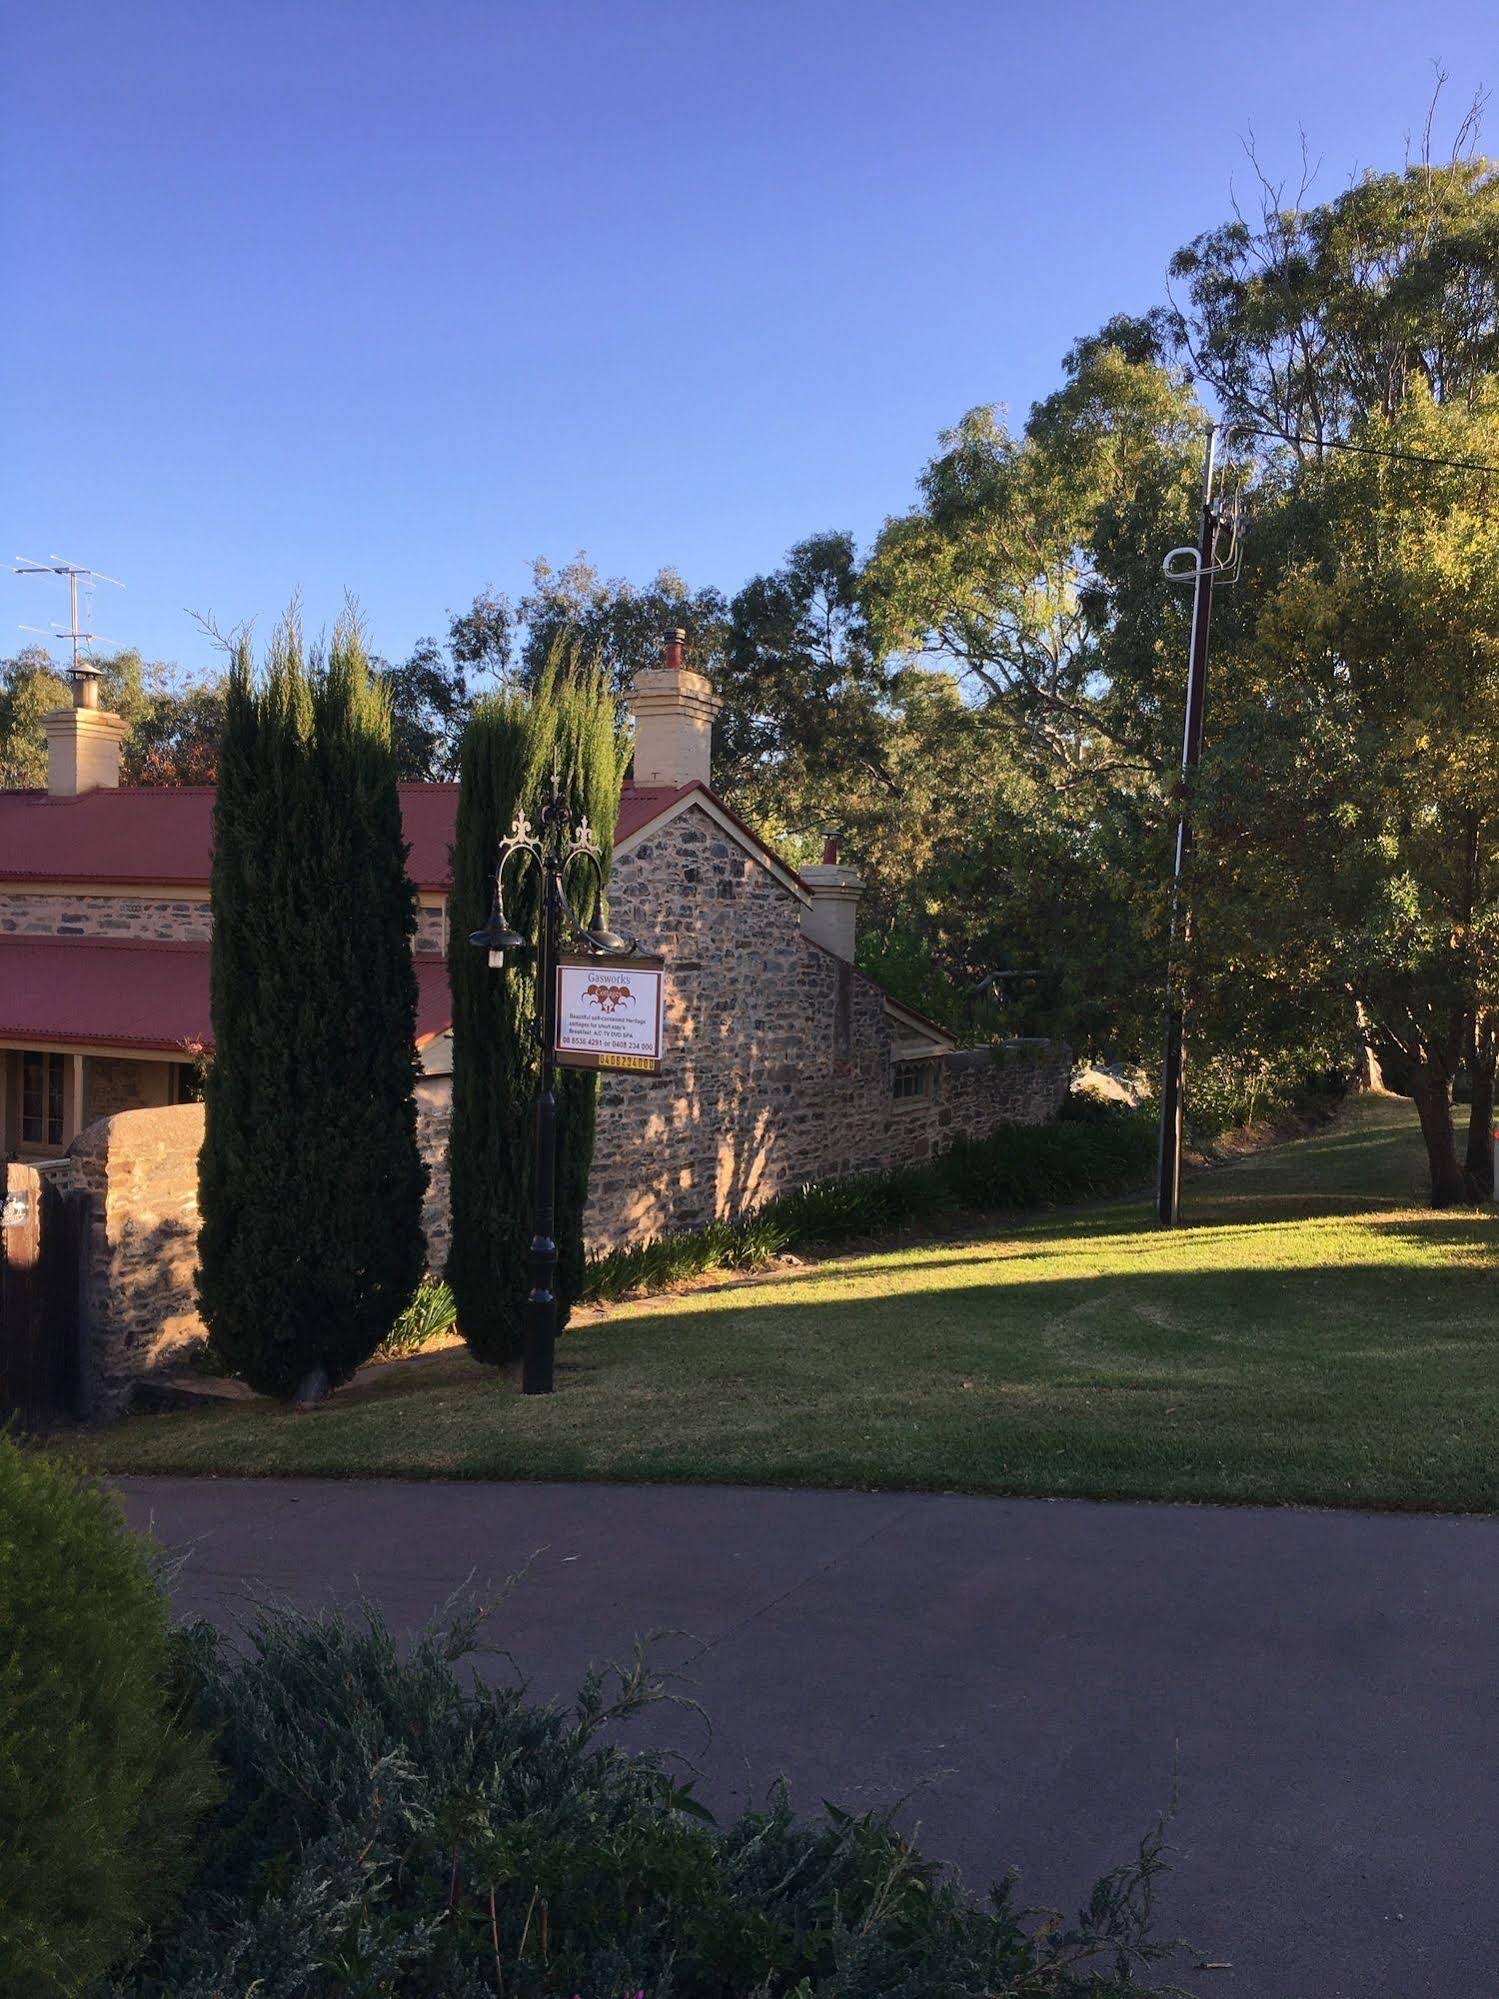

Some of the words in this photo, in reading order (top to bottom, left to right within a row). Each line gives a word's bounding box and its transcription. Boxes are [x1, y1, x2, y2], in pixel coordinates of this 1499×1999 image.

[588, 972, 631, 985] Gasworks
[588, 1038, 602, 1046] 4291
[612, 1040, 627, 1048] 0408
[641, 1043, 653, 1051] 000
